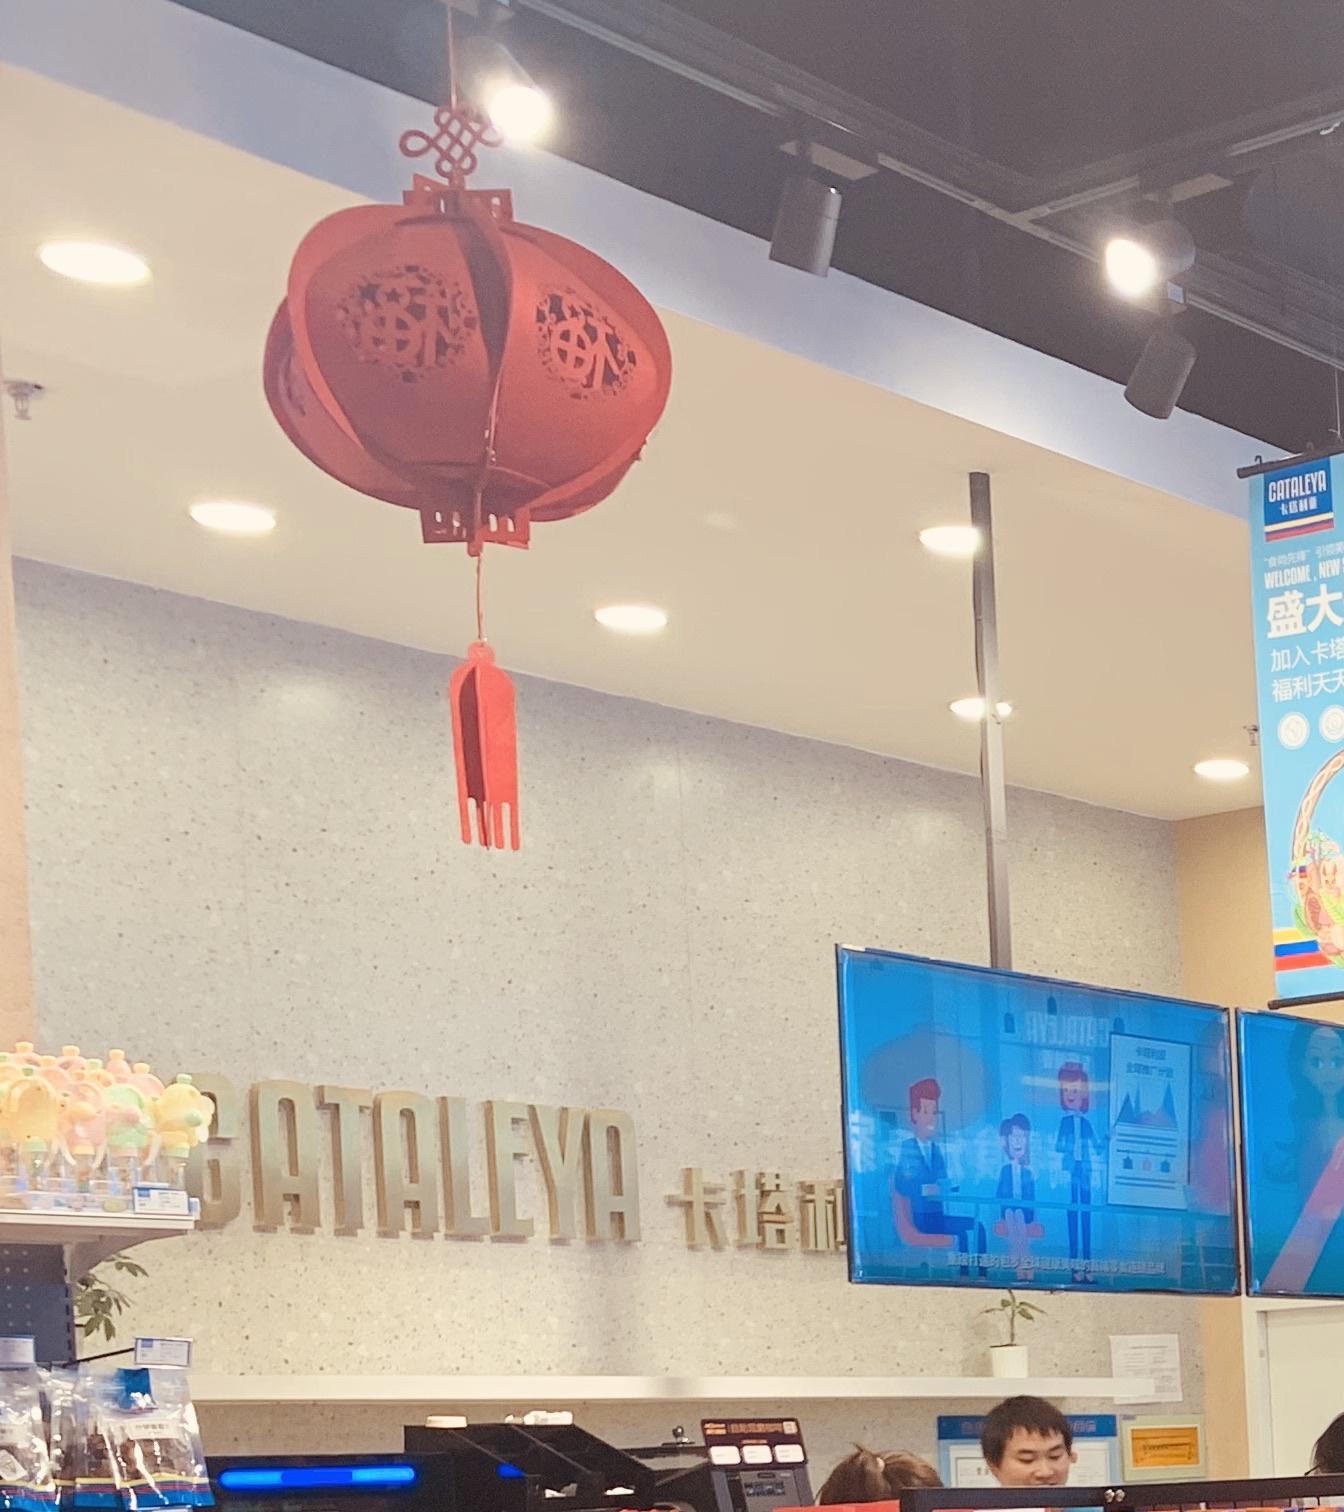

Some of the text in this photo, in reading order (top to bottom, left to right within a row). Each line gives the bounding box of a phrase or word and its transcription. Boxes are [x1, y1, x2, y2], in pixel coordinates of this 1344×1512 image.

[1269, 470, 1326, 502] CATALEYA
[1319, 557, 1341, 579] NEW
[666, 1166, 847, 1252] 卡塔利
